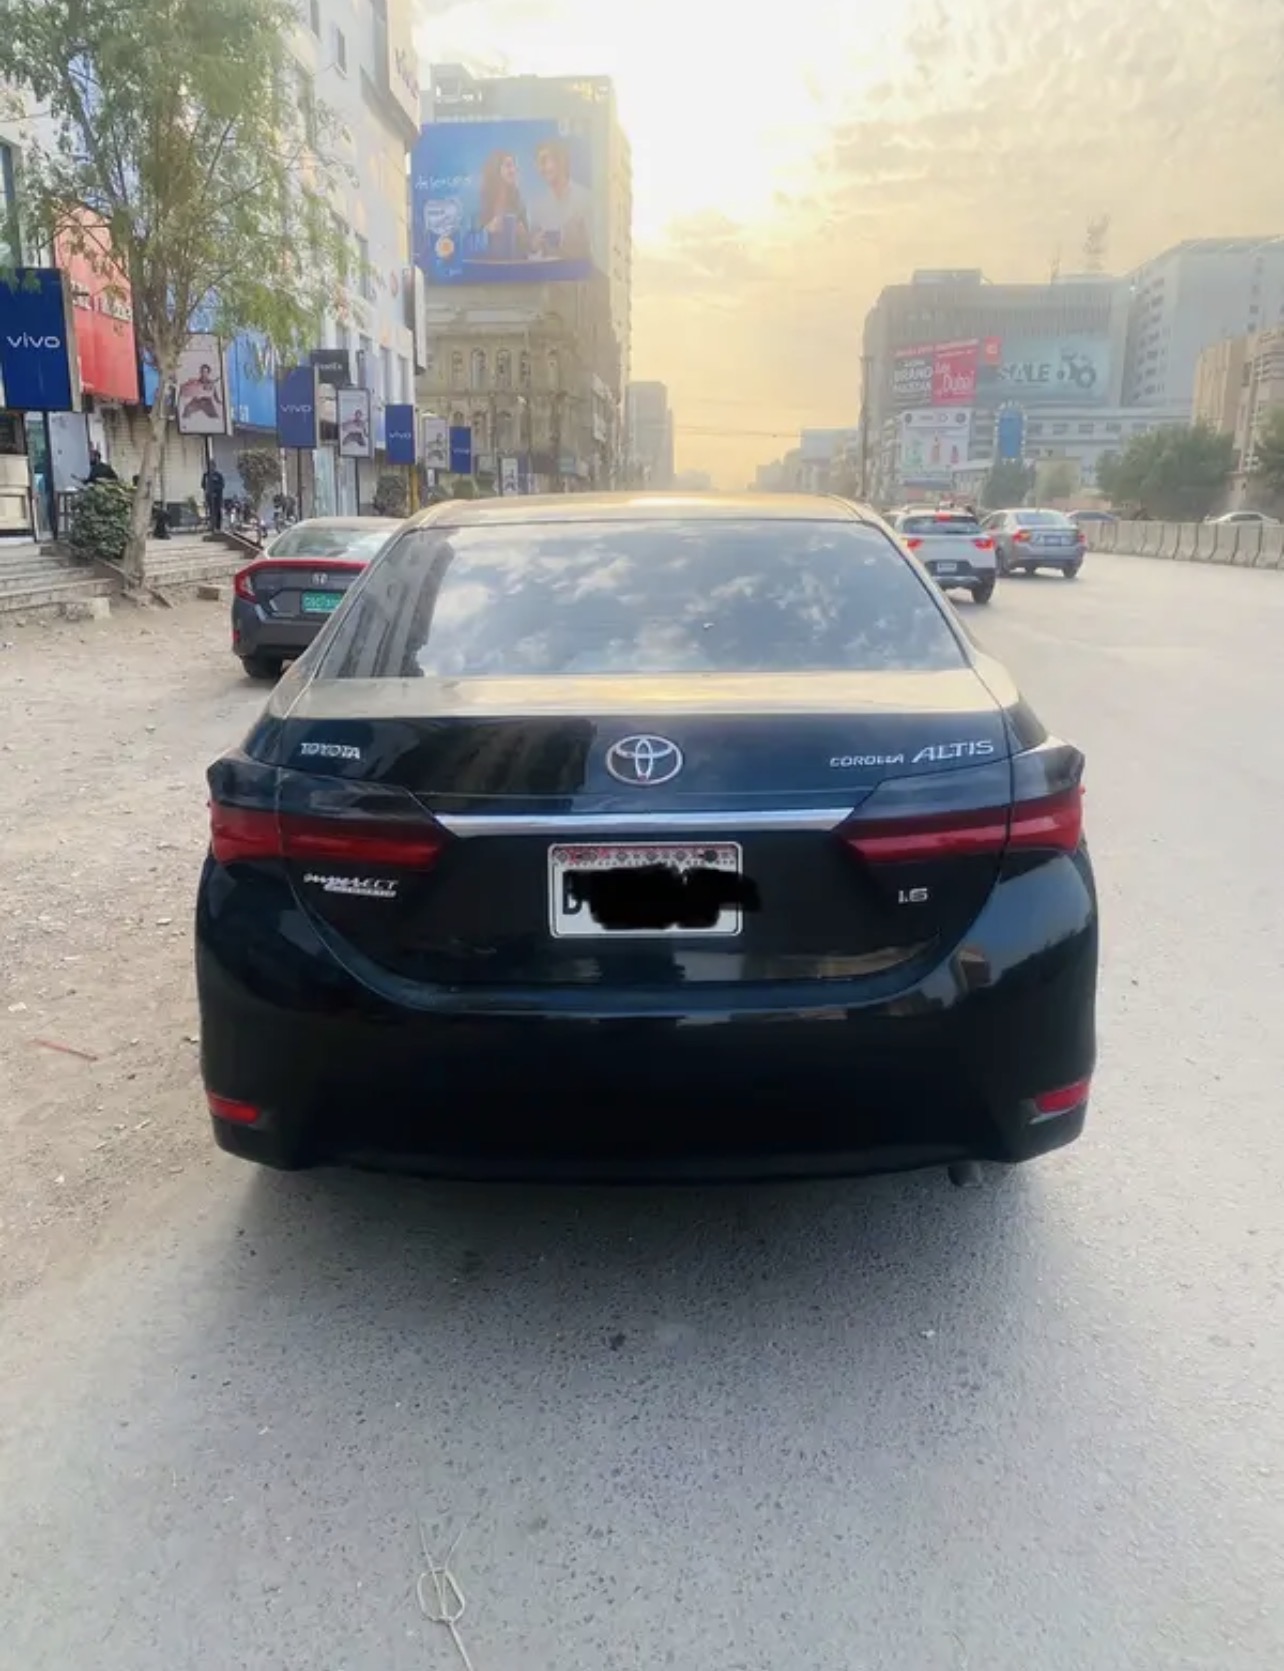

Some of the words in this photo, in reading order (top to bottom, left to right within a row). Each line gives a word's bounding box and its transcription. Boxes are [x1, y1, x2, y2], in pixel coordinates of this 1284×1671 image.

[6, 331, 61, 349] vivo
[301, 742, 361, 760] TOYOTA
[829, 753, 905, 768] COROLLA
[911, 739, 995, 763] ALTIS
